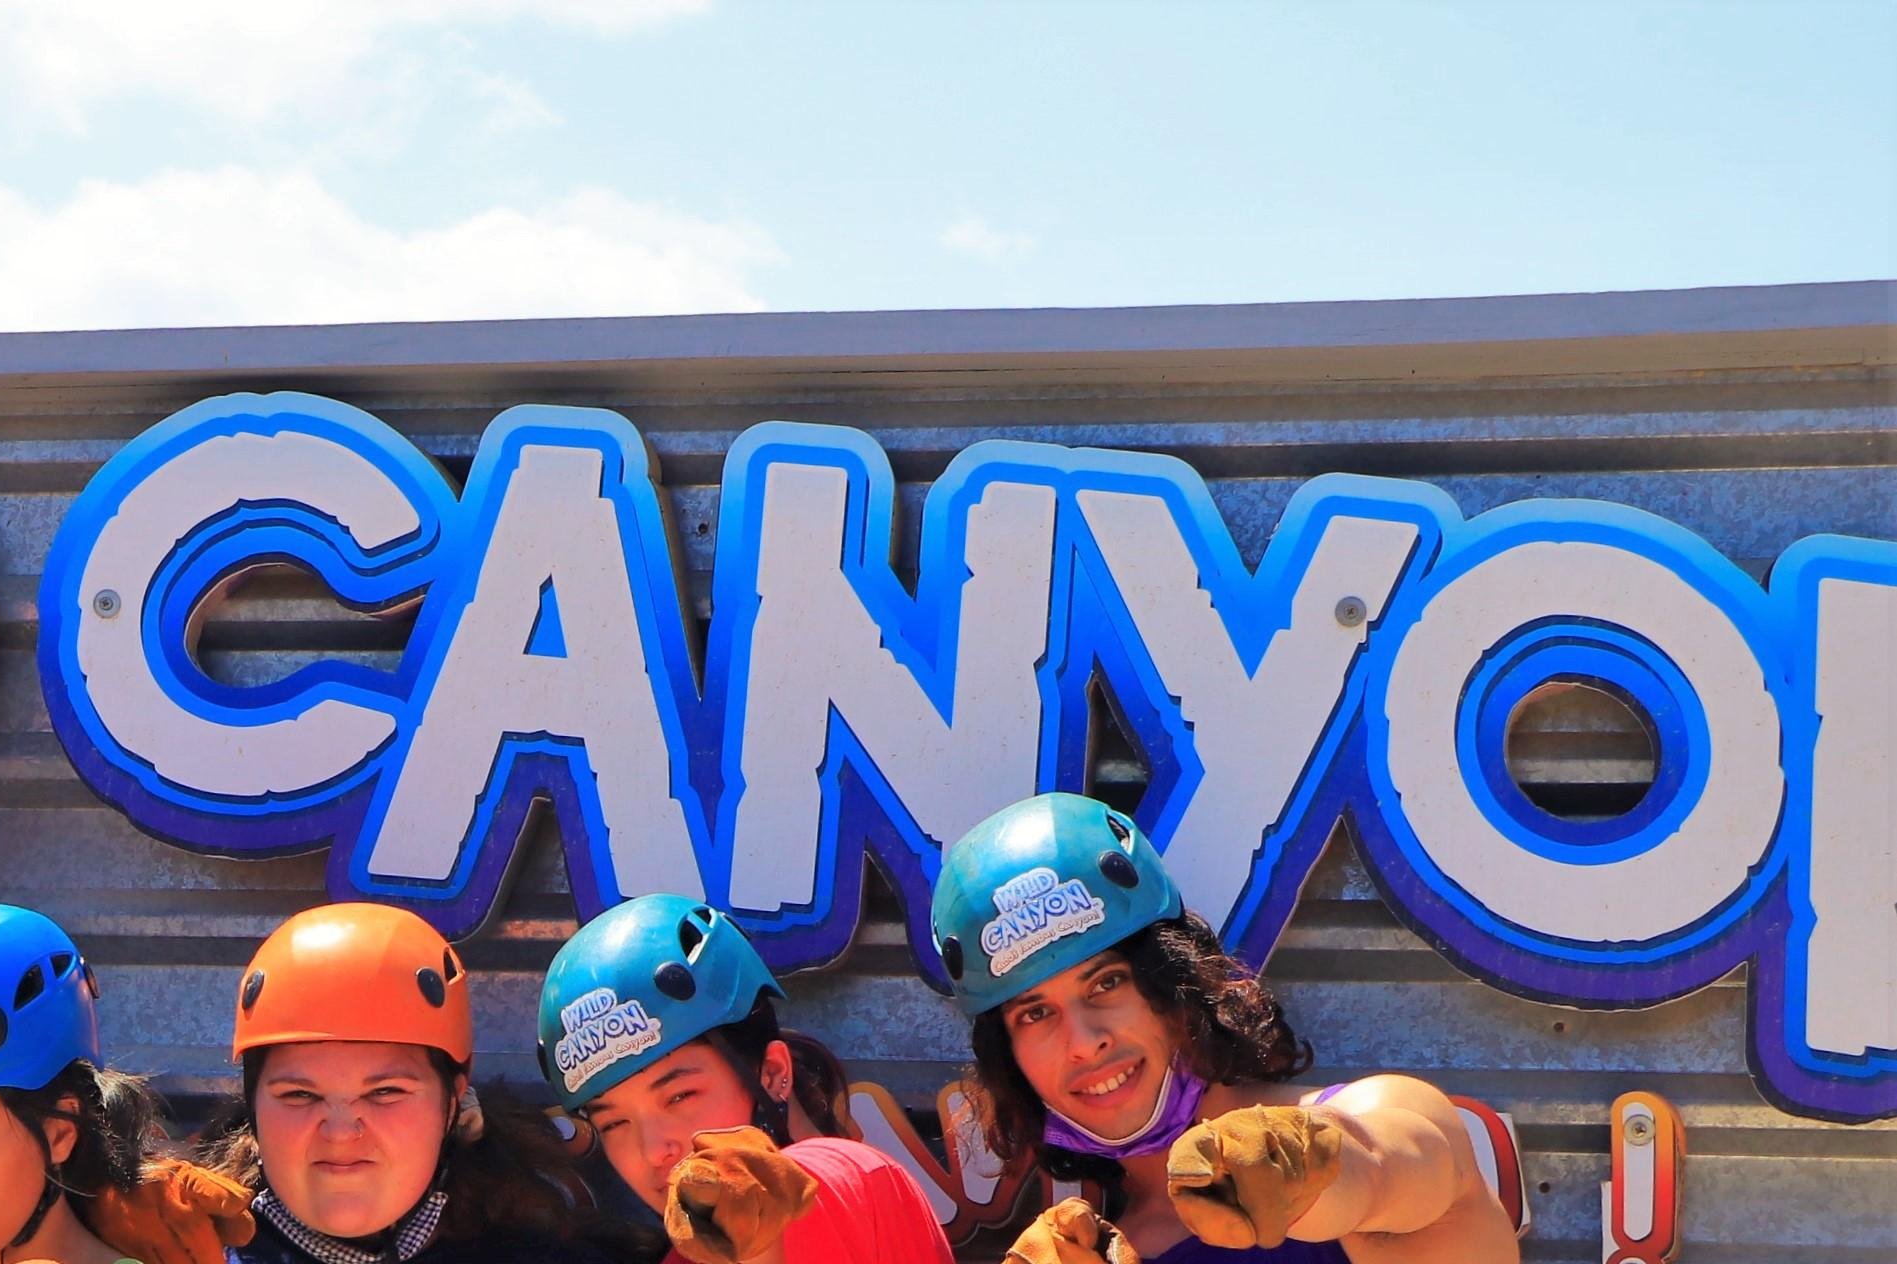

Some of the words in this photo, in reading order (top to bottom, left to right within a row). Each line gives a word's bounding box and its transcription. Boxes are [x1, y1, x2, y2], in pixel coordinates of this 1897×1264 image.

[984, 882, 1092, 953] CANYON
[995, 872, 1054, 912] WILD
[557, 1003, 649, 1071] CANYON
[564, 992, 615, 1033] WILD
